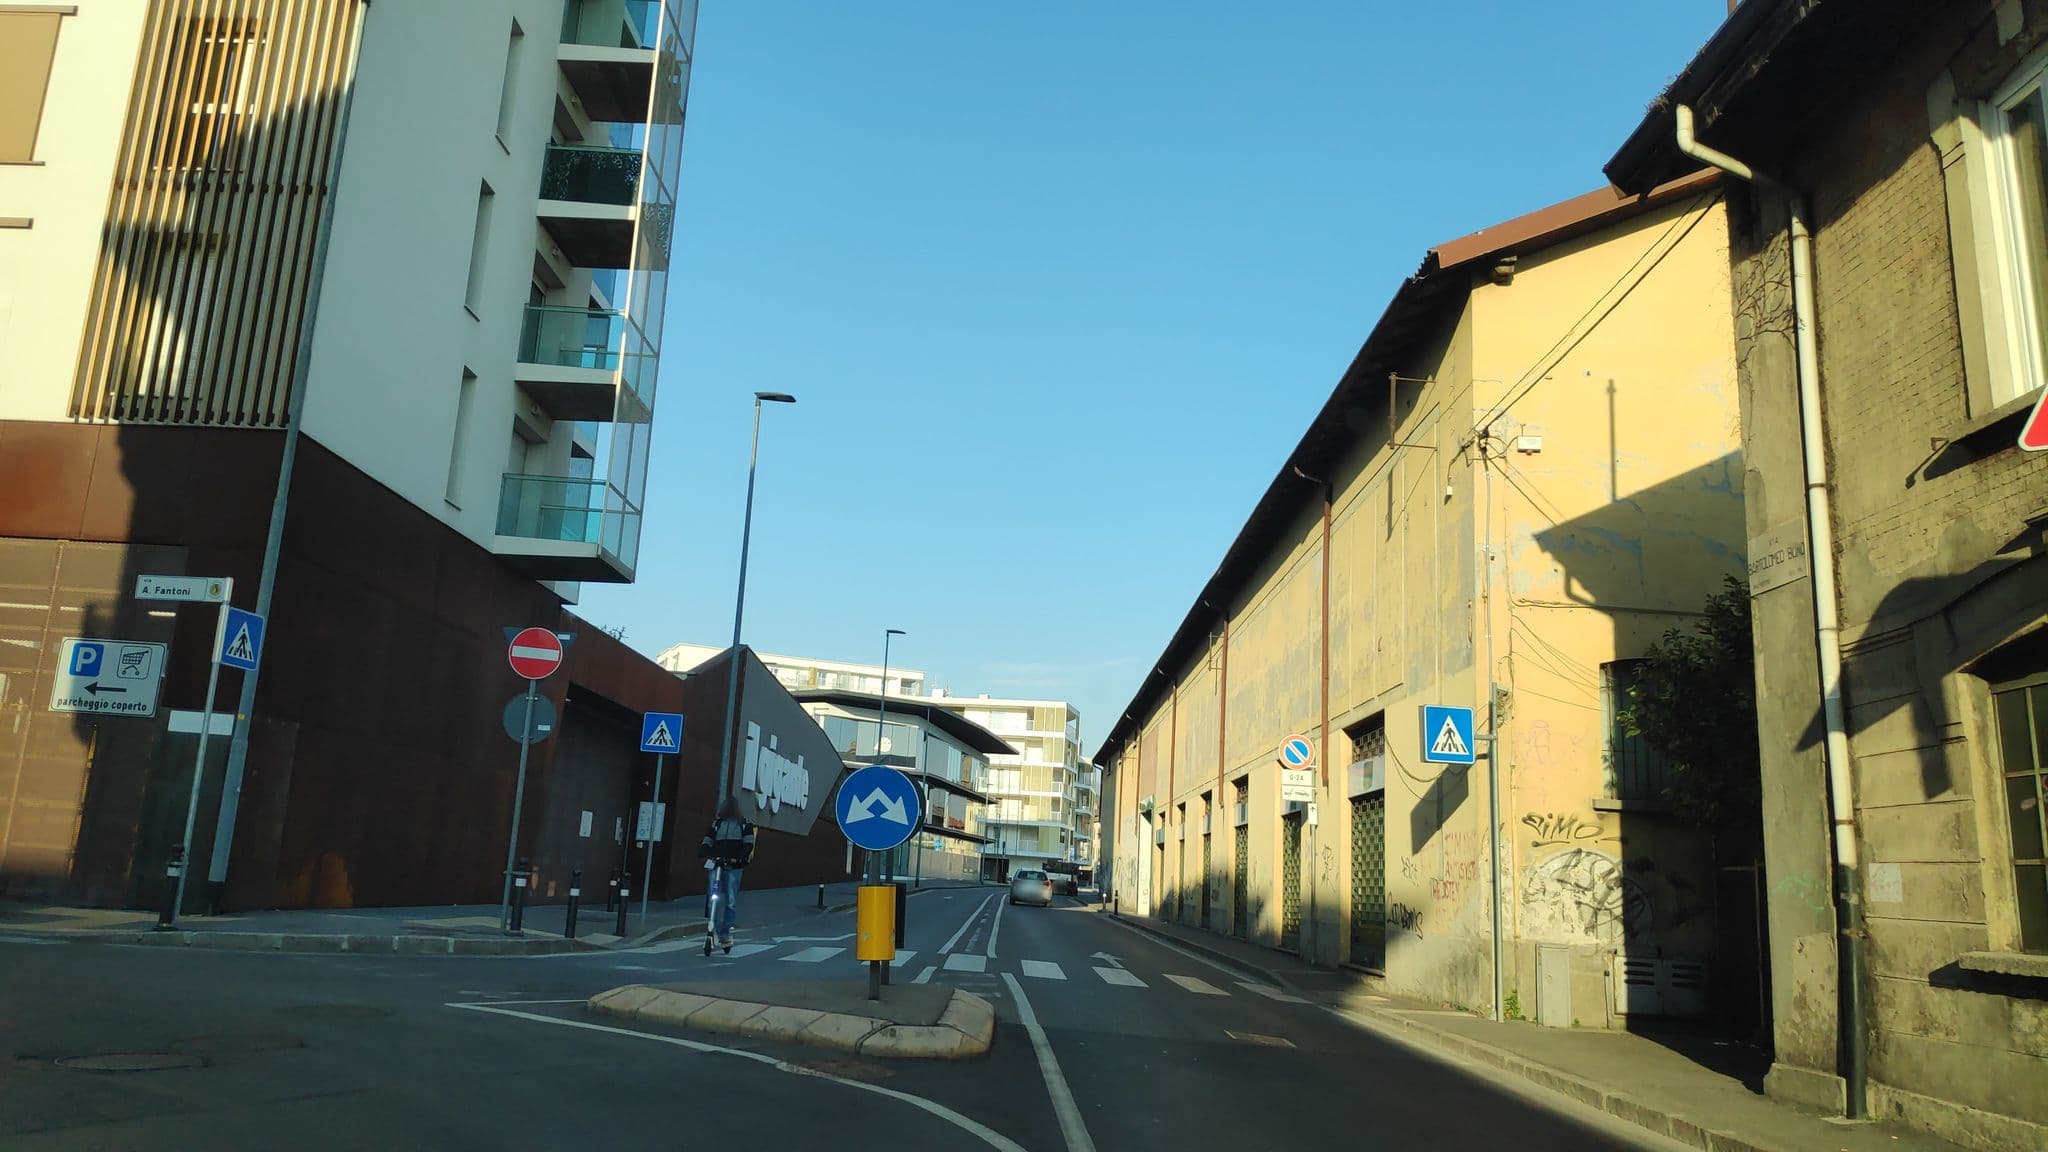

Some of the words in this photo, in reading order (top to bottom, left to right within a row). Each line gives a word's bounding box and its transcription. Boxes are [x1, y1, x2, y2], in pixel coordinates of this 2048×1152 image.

[155, 586, 191, 596] Fantoni
[76, 646, 97, 673] P
[57, 697, 109, 711] parcheggio
[111, 701, 147, 712] coperto
